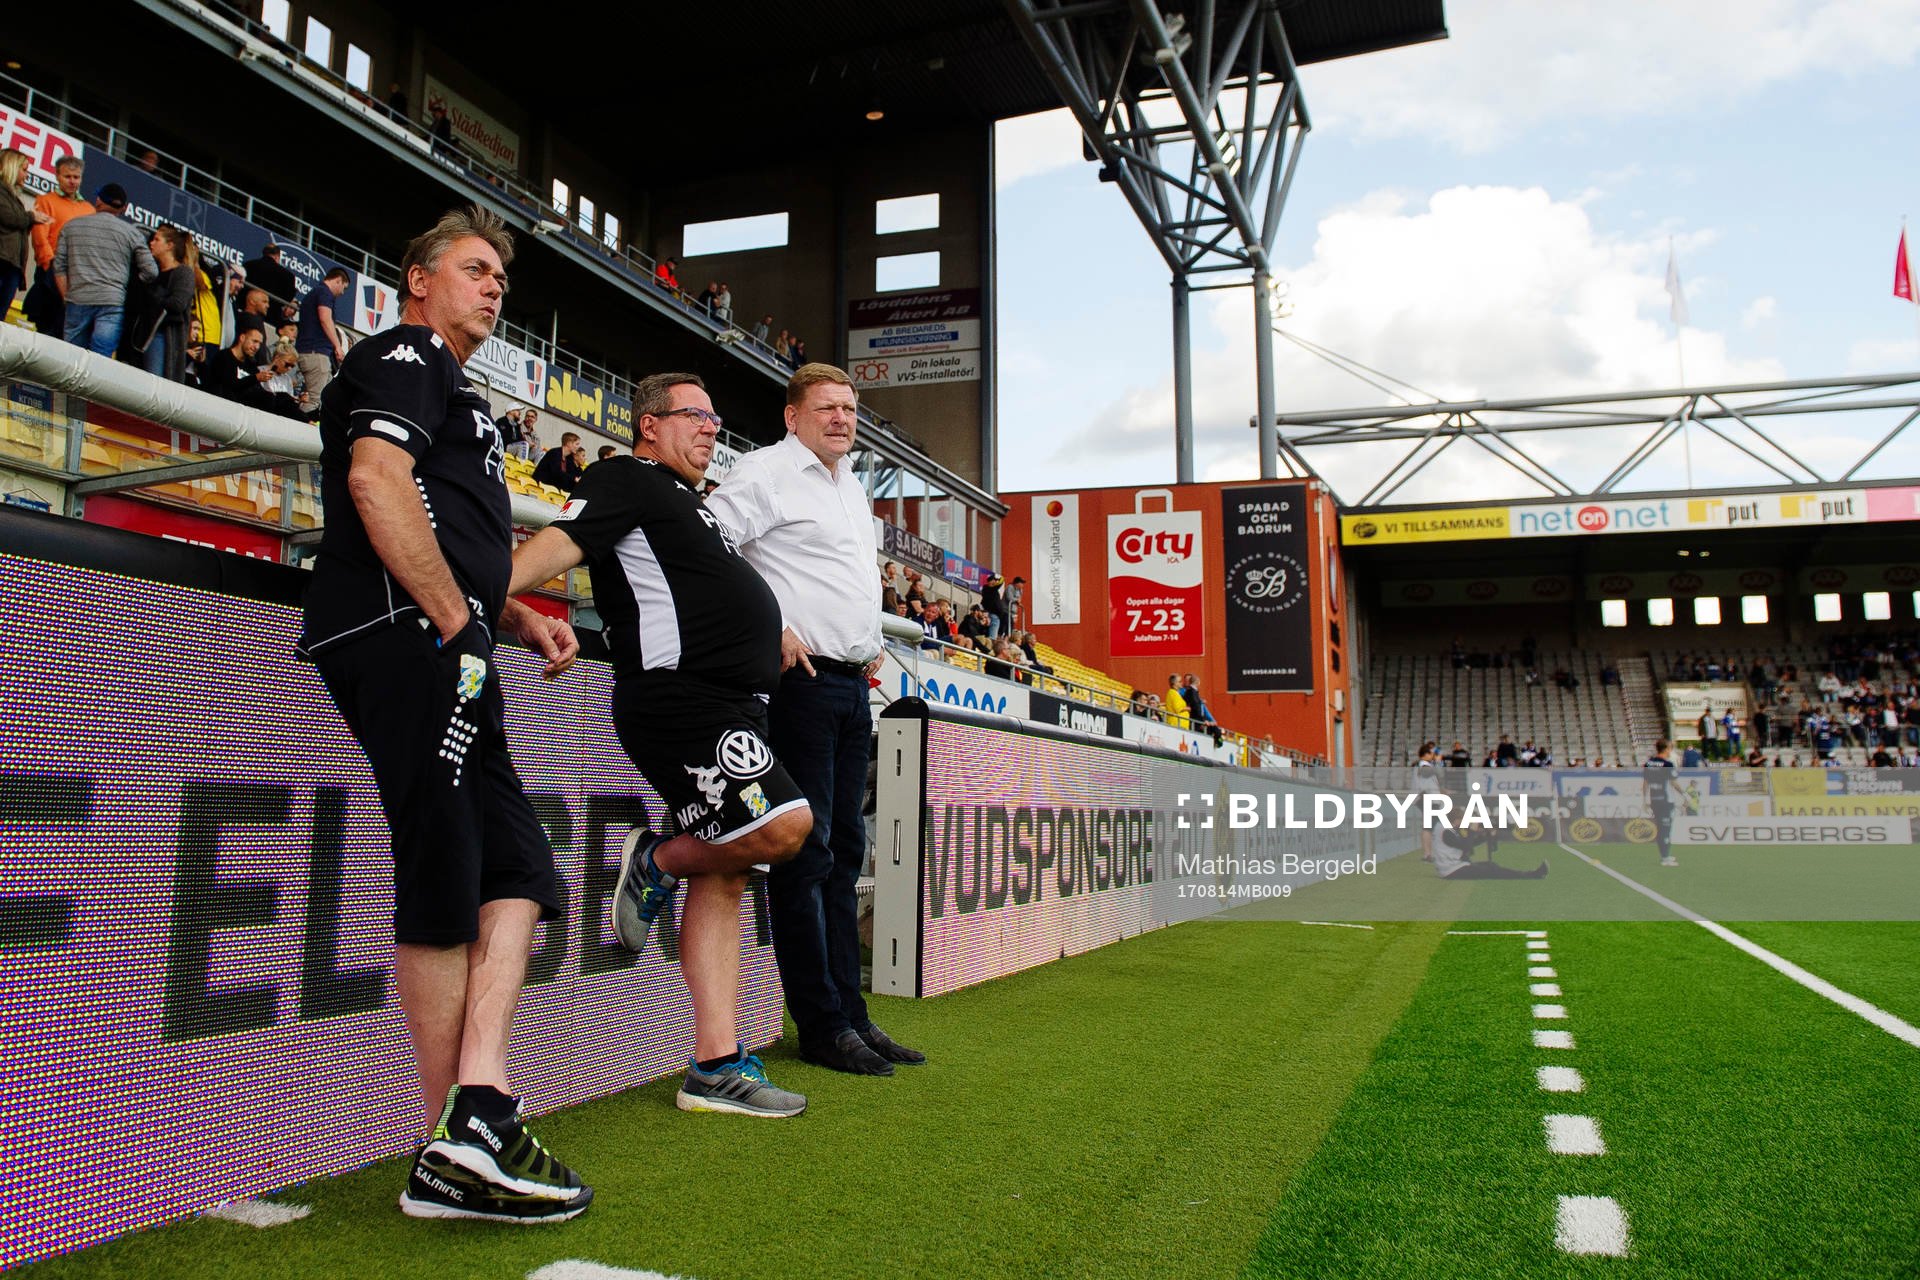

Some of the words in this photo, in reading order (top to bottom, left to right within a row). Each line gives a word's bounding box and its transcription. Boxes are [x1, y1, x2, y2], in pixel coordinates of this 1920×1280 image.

[279, 250, 321, 281] Fräscht
[858, 294, 952, 311] Lövdalens
[887, 308, 938, 321] Åkeri
[942, 305, 970, 316] AB
[895, 324, 947, 335] BREDAREDS
[911, 360, 928, 369] Din
[930, 357, 960, 367] lokala
[897, 367, 975, 382] VVS-installatör!
[607, 402, 619, 417] AB
[1238, 501, 1290, 514] SPABAD
[1251, 513, 1278, 524] OCH
[1384, 523, 1398, 534] VI
[1403, 517, 1504, 533] TILLSAMMANS
[1237, 524, 1293, 536] BADRUM
[912, 537, 933, 562] BYGG
[1116, 528, 1194, 564] City
[1226, 552, 1262, 589] SVENSKA
[1126, 597, 1149, 606] Öppet
[1150, 597, 1163, 605] alla
[1163, 597, 1185, 606] dagar
[1126, 609, 1186, 632] 7-23
[1242, 668, 1297, 676] SVENSKABAD.SE
[1688, 826, 1887, 842] SVEDBERGS
[476, 1122, 503, 1153] Route
